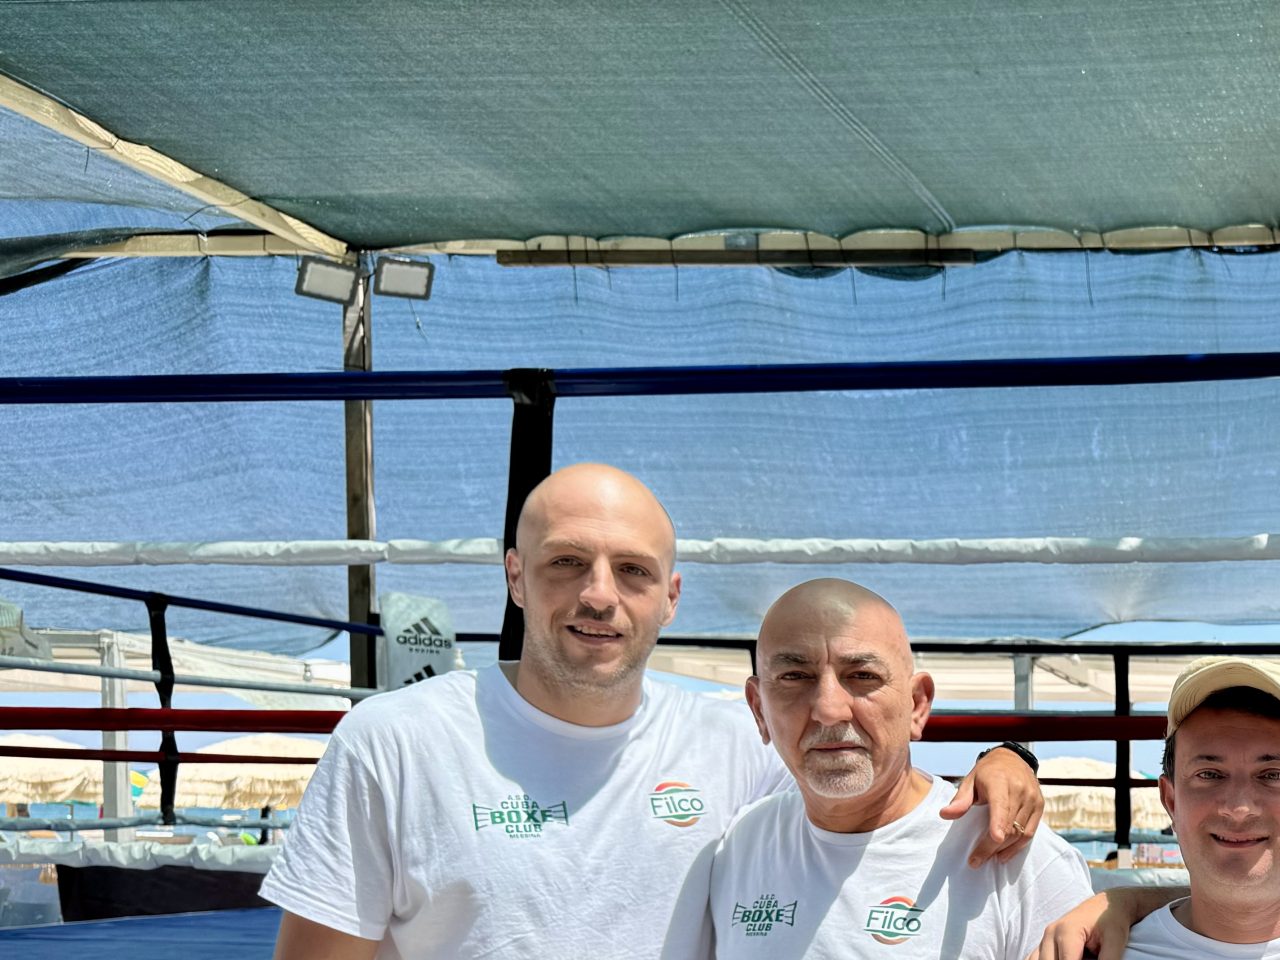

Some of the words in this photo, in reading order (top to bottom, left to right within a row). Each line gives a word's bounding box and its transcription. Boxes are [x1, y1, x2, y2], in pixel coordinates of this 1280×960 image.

[396, 634, 452, 649] adidas
[500, 800, 540, 809] CUBA
[650, 795, 704, 816] Filco
[490, 809, 554, 825] BOXE
[505, 823, 543, 833] CLUB
[752, 900, 778, 909] CUBA
[740, 909, 785, 923] BOXE
[866, 909, 922, 932] Filco
[746, 923, 772, 931] CLUB
